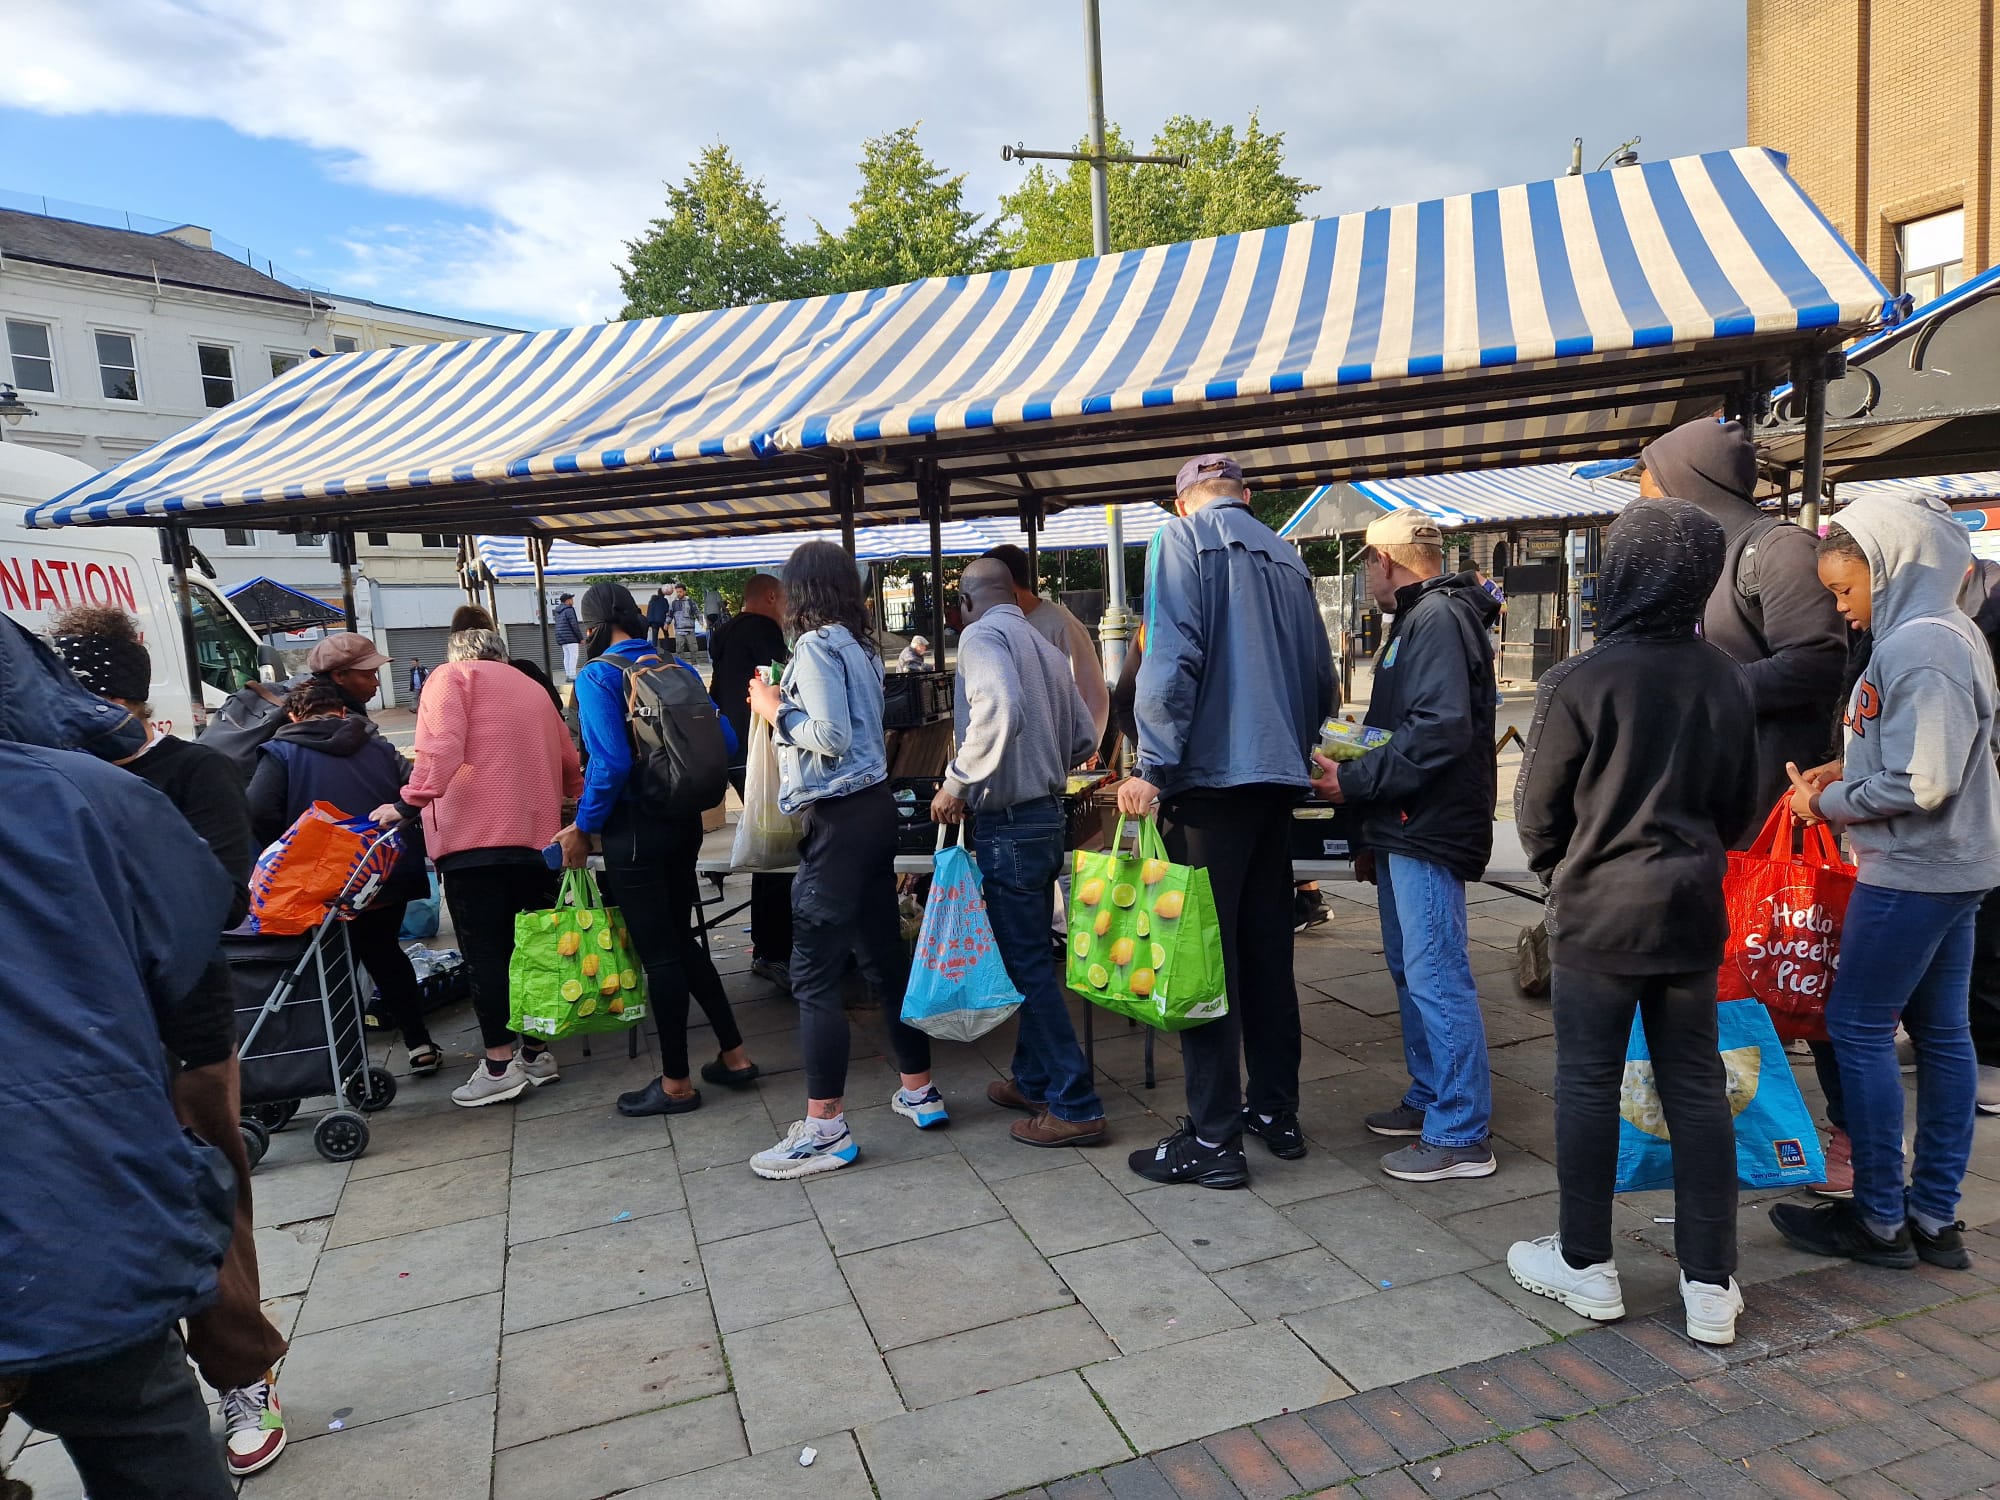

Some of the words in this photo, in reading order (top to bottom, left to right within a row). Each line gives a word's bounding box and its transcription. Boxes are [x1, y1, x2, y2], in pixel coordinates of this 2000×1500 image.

[0, 557, 138, 614] NATION
[1842, 671, 1883, 739] P
[1771, 902, 1833, 933] Hello
[1777, 960, 1828, 998] Pie!
[624, 1006, 641, 1018] SDA
